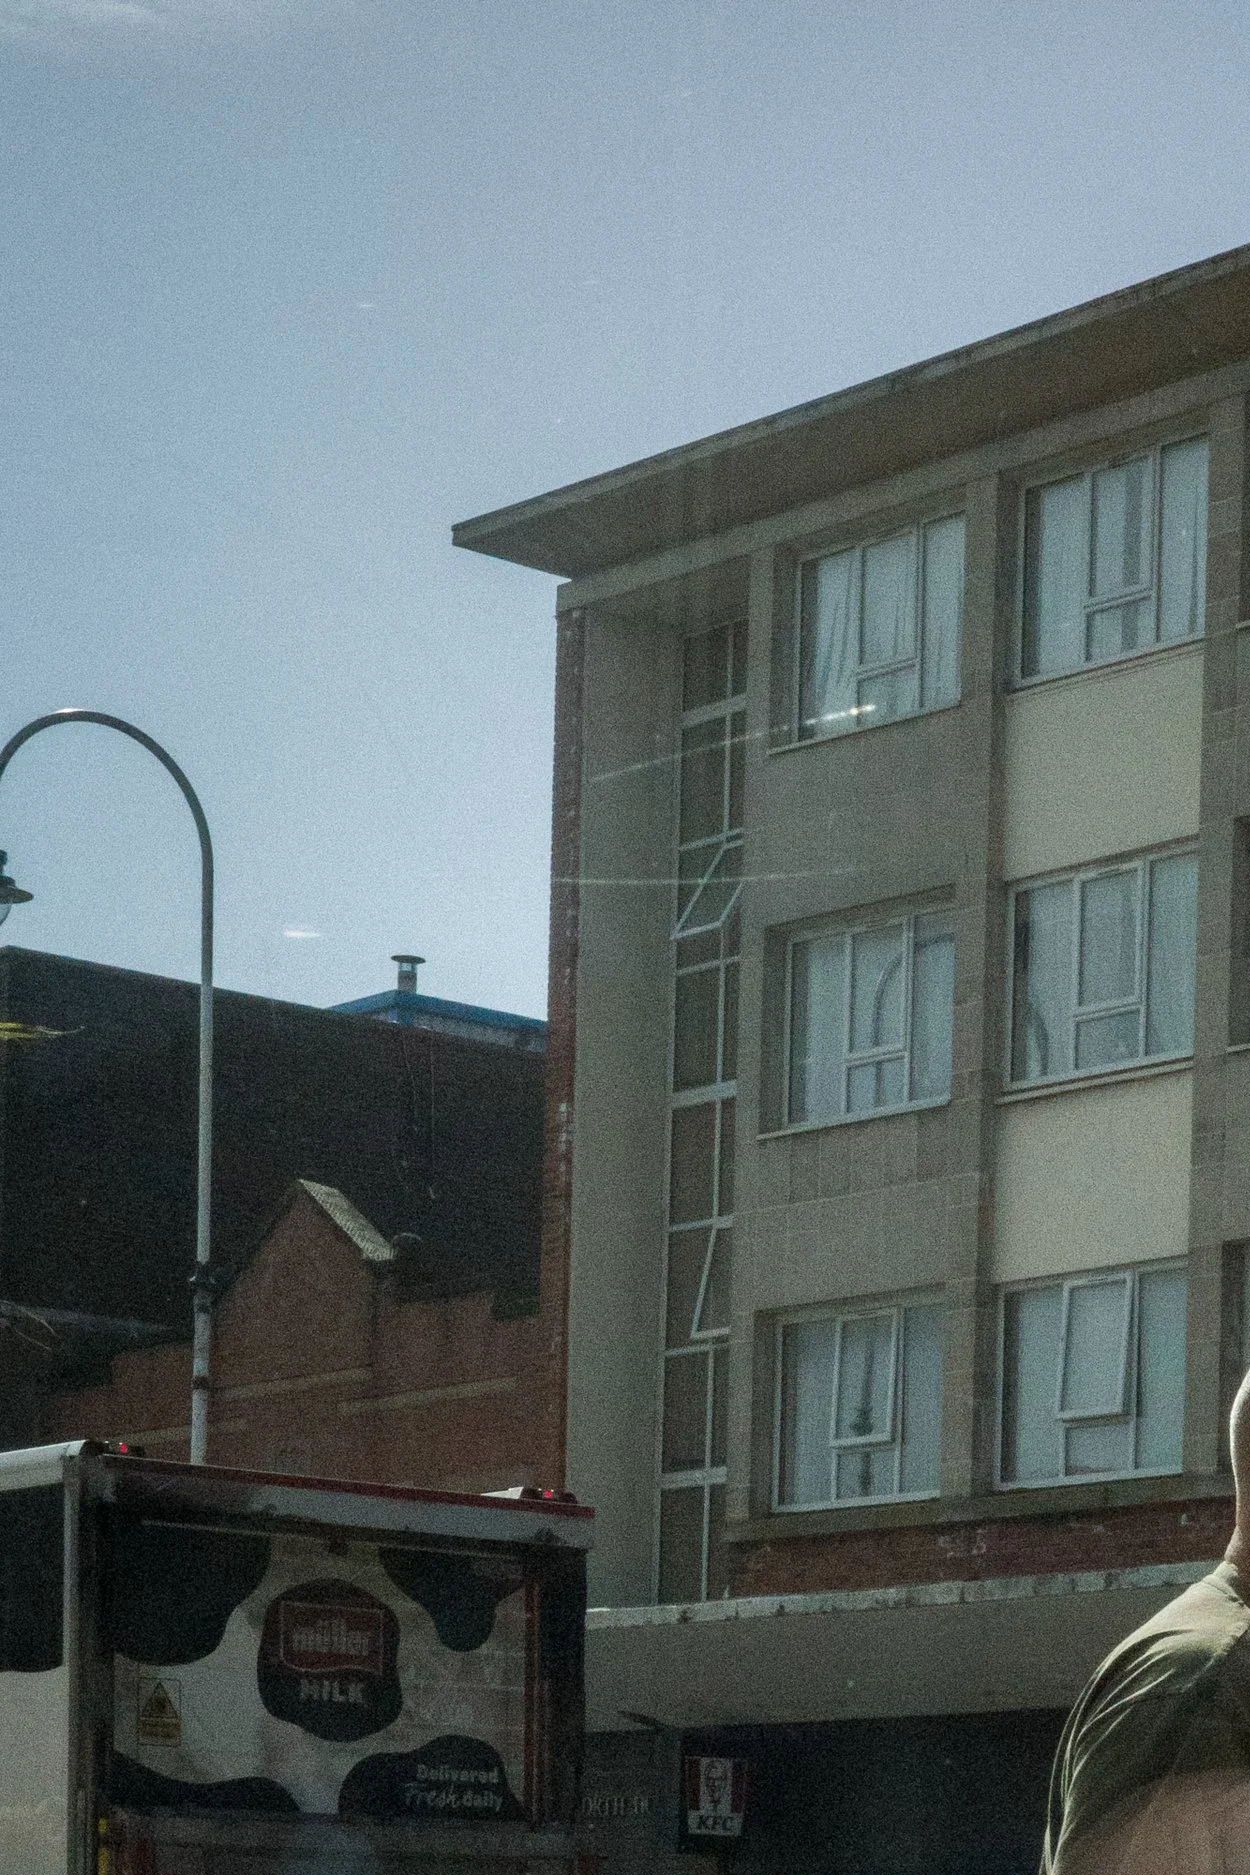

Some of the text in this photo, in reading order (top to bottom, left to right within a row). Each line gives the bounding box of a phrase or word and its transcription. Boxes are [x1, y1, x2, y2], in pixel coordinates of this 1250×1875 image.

[300, 1679, 367, 1705] MILK
[416, 1763, 499, 1784] Delivered
[462, 1788, 503, 1812] daily
[696, 1814, 734, 1832] KFC
